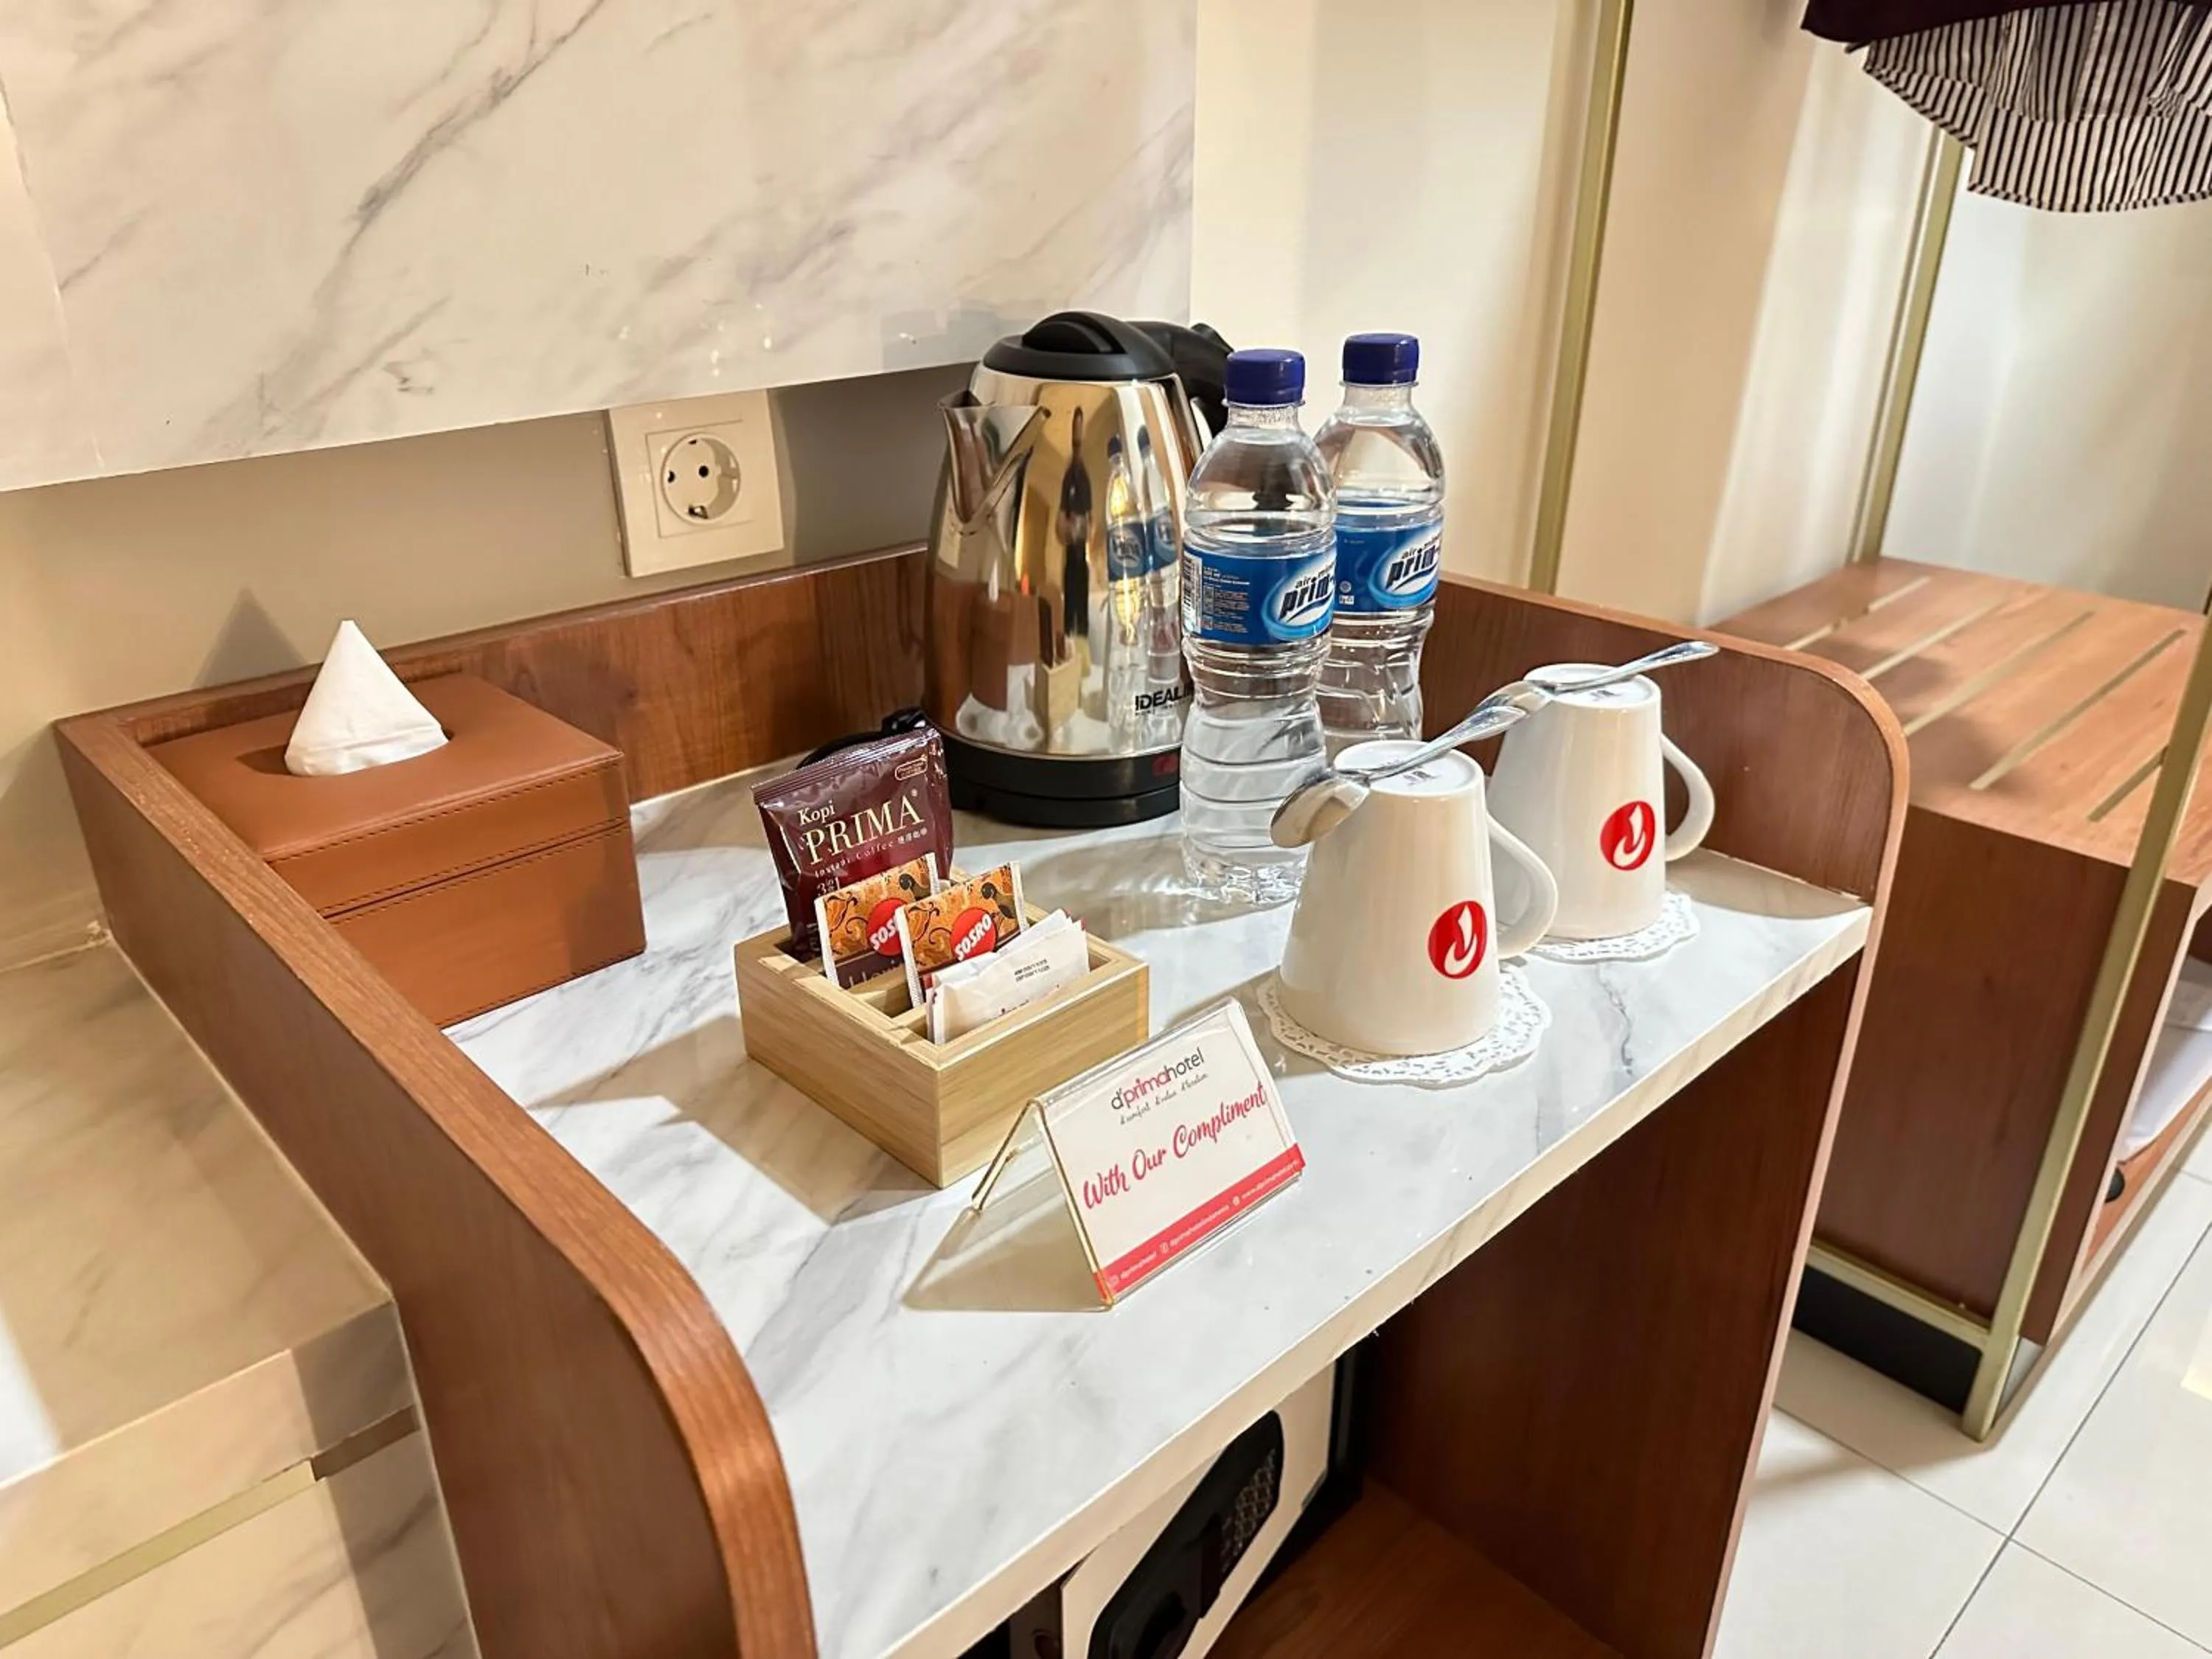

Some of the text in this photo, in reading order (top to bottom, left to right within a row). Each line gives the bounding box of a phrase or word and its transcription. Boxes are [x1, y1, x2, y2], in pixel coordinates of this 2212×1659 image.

[1385, 545, 1440, 590] prim
[1279, 574, 1335, 621] prim
[798, 800, 835, 826] Kopi
[803, 796, 925, 865] PRIMA
[869, 918, 897, 950] SOS
[955, 914, 992, 961] SOSRO
[1083, 1080, 1267, 1210] With Our Compliment
